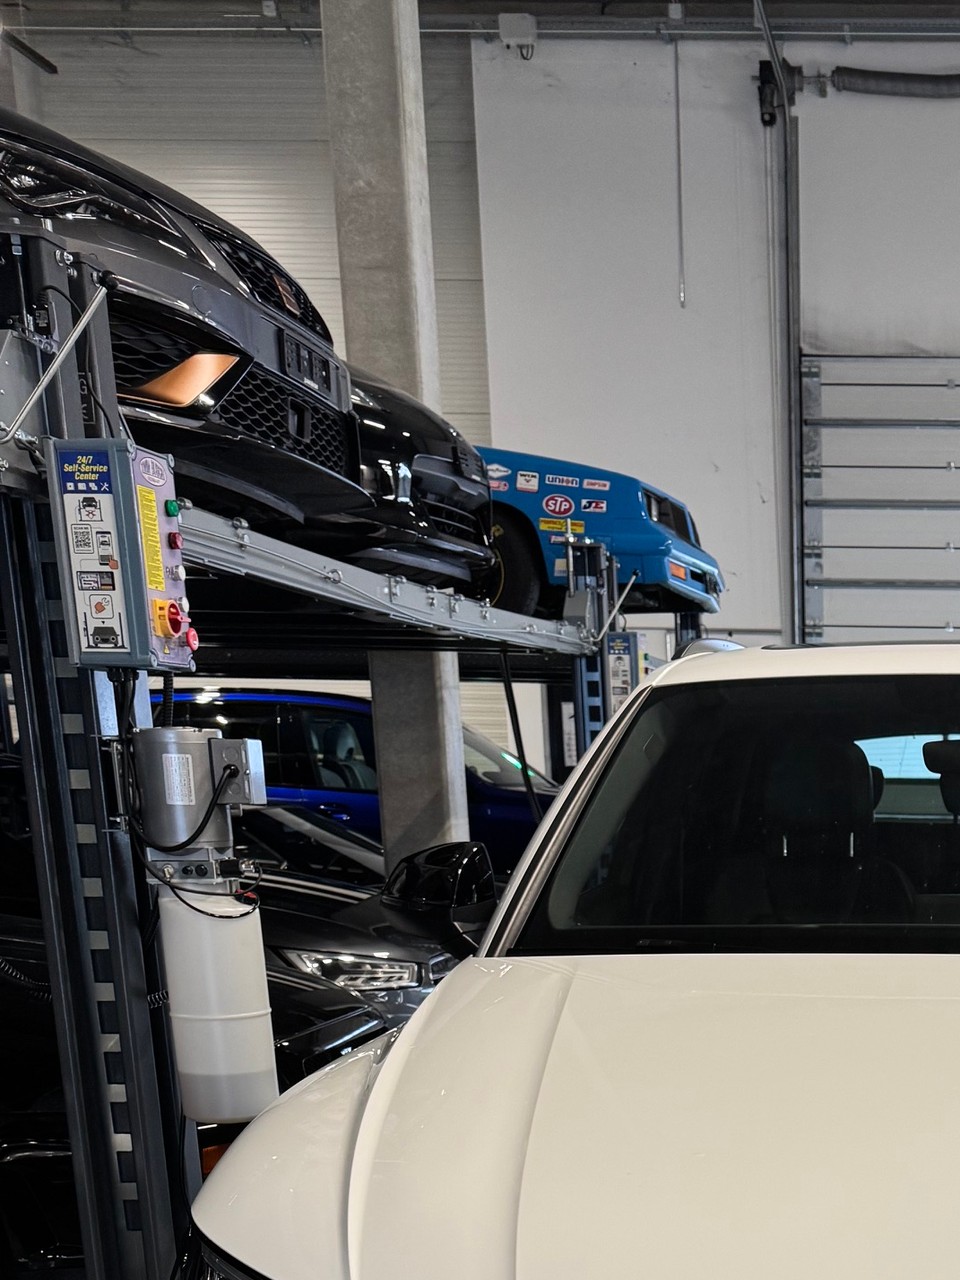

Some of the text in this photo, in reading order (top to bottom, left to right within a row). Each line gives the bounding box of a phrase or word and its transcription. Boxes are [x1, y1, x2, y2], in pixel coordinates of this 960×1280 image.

[76, 455, 93, 464] 24/7
[63, 463, 108, 473] Self-Service
[74, 472, 99, 480] Center
[547, 497, 570, 512] STP
